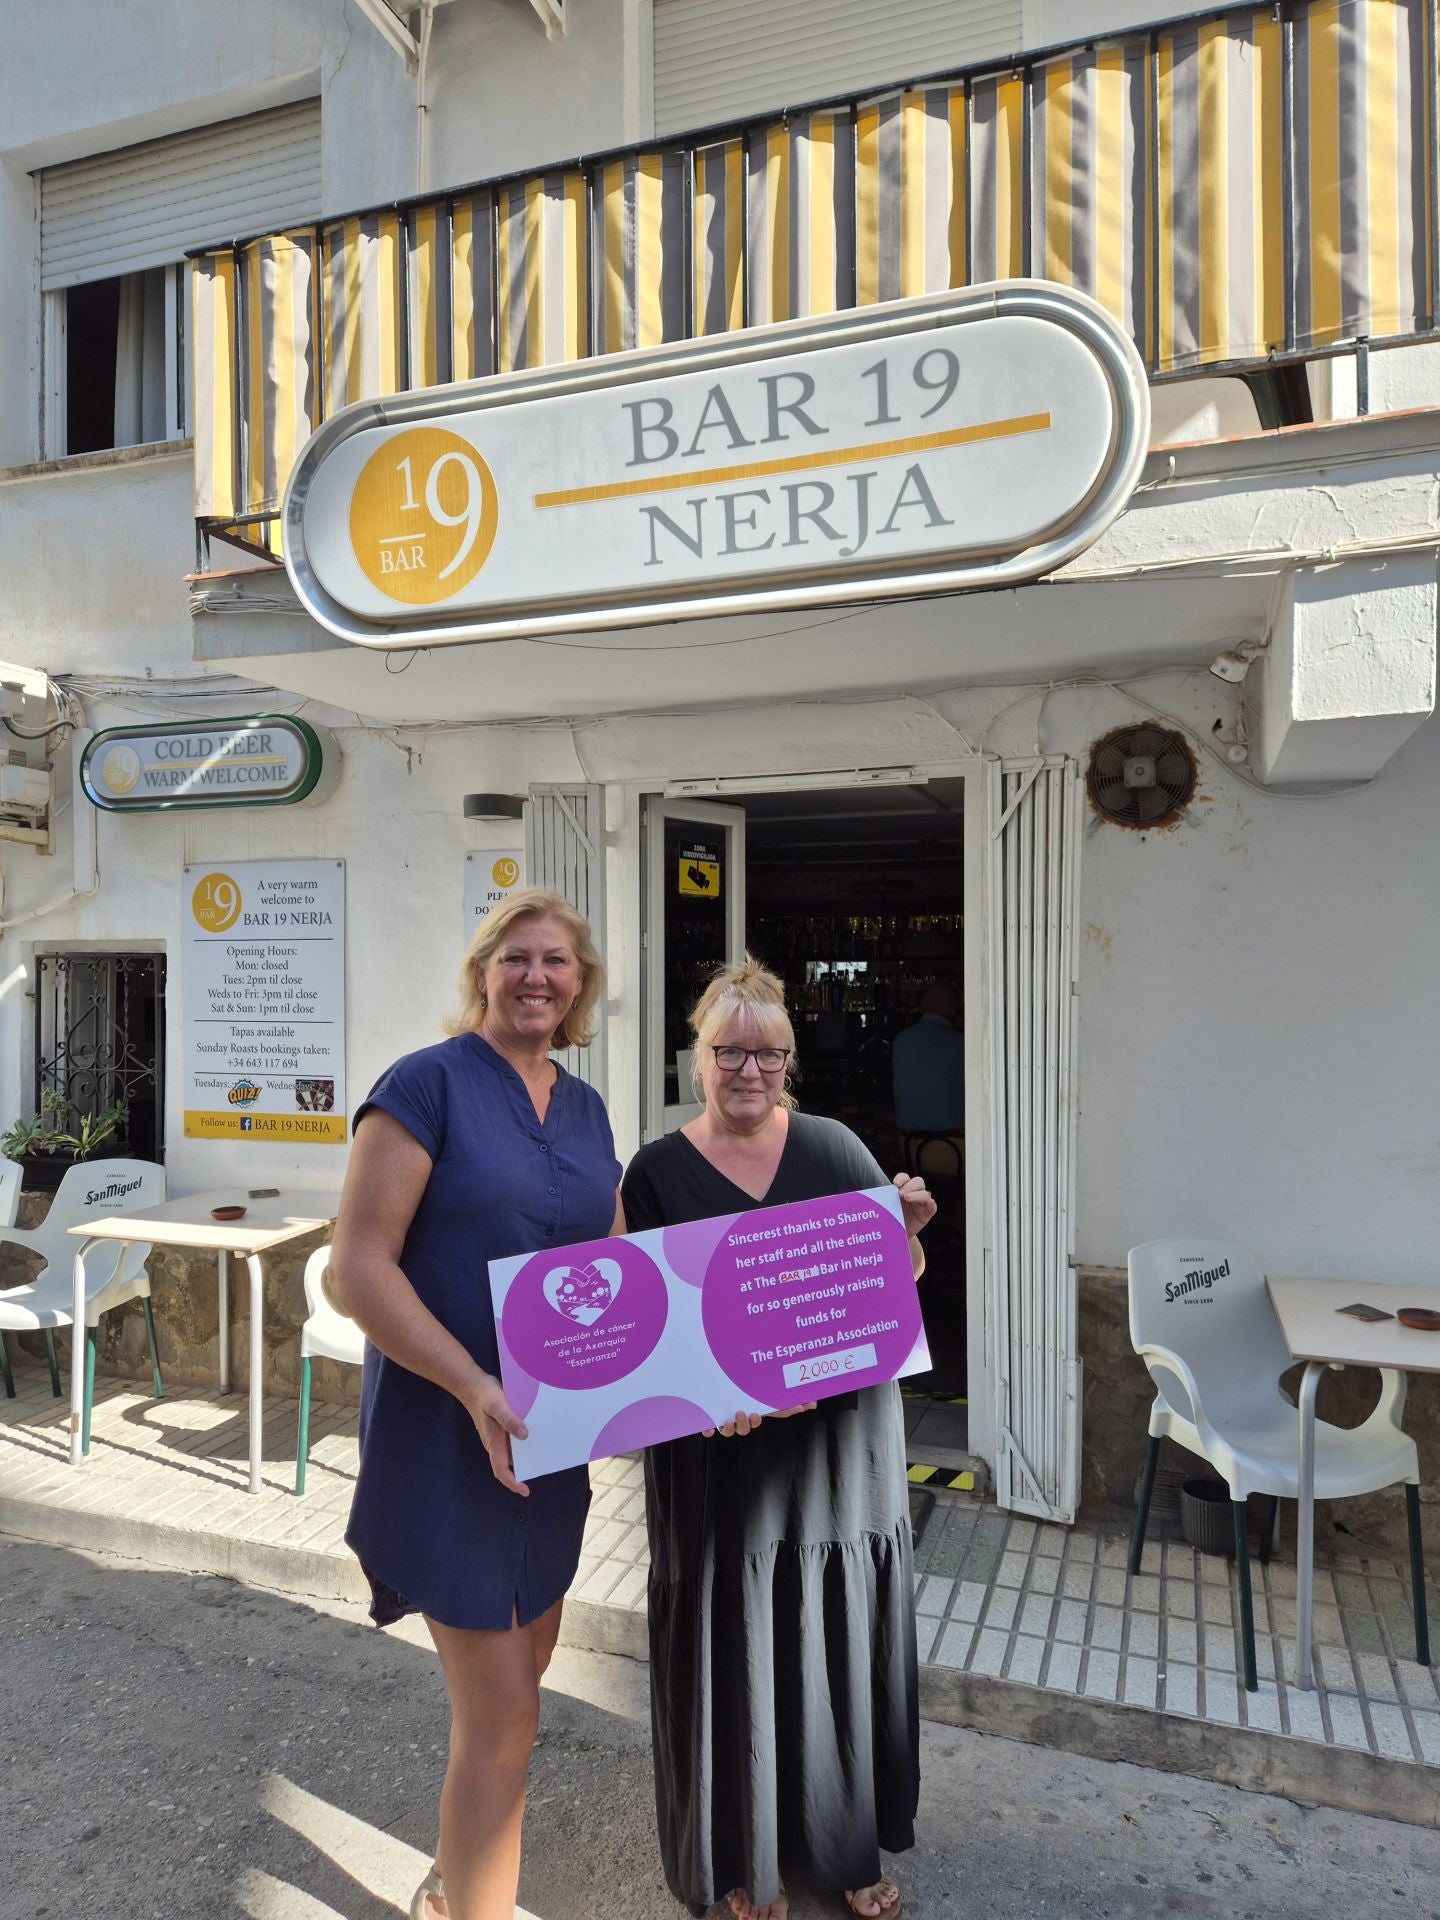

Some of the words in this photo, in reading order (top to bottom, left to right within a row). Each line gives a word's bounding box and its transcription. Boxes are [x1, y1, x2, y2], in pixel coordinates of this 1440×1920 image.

[621, 370, 829, 467] BAR
[860, 348, 960, 428] 19
[395, 451, 482, 580] 19
[639, 462, 955, 567] NERJA
[379, 544, 426, 575] BAR
[155, 737, 213, 760] COLD
[220, 734, 273, 756] BEER
[144, 770, 195, 788] WARM
[199, 765, 288, 785] WELCOME
[257, 880, 265, 890] A
[268, 881, 288, 892] very
[290, 879, 318, 889] warm
[205, 881, 237, 926] 19
[260, 894, 304, 905] welcome
[305, 894, 315, 904] to
[243, 913, 270, 926] BAR
[274, 913, 287, 925] 19
[290, 911, 333, 927] NERJA
[475, 906, 489, 915] DO
[226, 946, 265, 958] Opening
[267, 945, 298, 956] Hours:
[235, 960, 259, 970] Mon:
[261, 960, 289, 970] closed
[222, 974, 245, 985] Tues:
[246, 975, 267, 987] 2pm
[269, 974, 278, 985] til
[280, 974, 303, 985] close
[208, 988, 231, 999] Weds
[233, 989, 242, 999] to
[244, 988, 260, 999] Fri:
[261, 988, 282, 1001] 3pm
[284, 988, 293, 999] til
[295, 988, 318, 999] close
[211, 1002, 224, 1013] Sat
[226, 1003, 235, 1013] &
[236, 1002, 256, 1013] Sun:
[259, 1003, 278, 1016] 1pm
[281, 1002, 290, 1013] til
[292, 1002, 315, 1014] close
[229, 1026, 255, 1038] Tapas
[257, 1026, 295, 1038] available
[196, 1042, 229, 1055] Sunday
[231, 1043, 258, 1054] Roasts
[260, 1043, 301, 1056] bookings
[303, 1045, 331, 1055] taken:
[227, 1058, 243, 1068] +34
[246, 1058, 262, 1068] 643
[265, 1058, 280, 1068] 117
[282, 1059, 299, 1069] 694
[229, 1086, 262, 1104] QUIZ!
[201, 1117, 226, 1127] Follow
[228, 1118, 238, 1128] us:
[255, 1119, 276, 1131] BAR
[281, 1120, 292, 1131] 19
[295, 1120, 331, 1134] NERJA
[728, 1227, 782, 1247] Sincerest
[783, 1219, 822, 1236] thanks
[824, 1217, 836, 1228] to
[837, 1209, 880, 1225] Sharon,
[735, 1257, 755, 1269] her
[758, 1248, 784, 1264] staff
[786, 1244, 808, 1259] and
[810, 1241, 824, 1253] all
[826, 1237, 845, 1250] the
[847, 1230, 882, 1245] clients
[740, 1281, 752, 1292] at
[754, 1276, 776, 1289] The
[781, 1271, 800, 1282] BAR
[820, 1260, 839, 1275] Bar
[841, 1258, 852, 1269] in
[854, 1252, 883, 1269] Nerja
[747, 1302, 764, 1315] for
[767, 1300, 780, 1311] so
[783, 1284, 845, 1310] generously
[847, 1275, 885, 1292] raising
[795, 1312, 829, 1328] funds
[830, 1307, 847, 1320] for
[543, 1331, 591, 1348] Asociación
[593, 1328, 605, 1337] de
[608, 1321, 636, 1334] cáncer
[751, 1349, 774, 1364] The
[776, 1333, 834, 1358] Esperanza
[837, 1318, 899, 1341] Association
[558, 1349, 570, 1358] de
[572, 1346, 582, 1355] la
[844, 1354, 856, 1370] €
